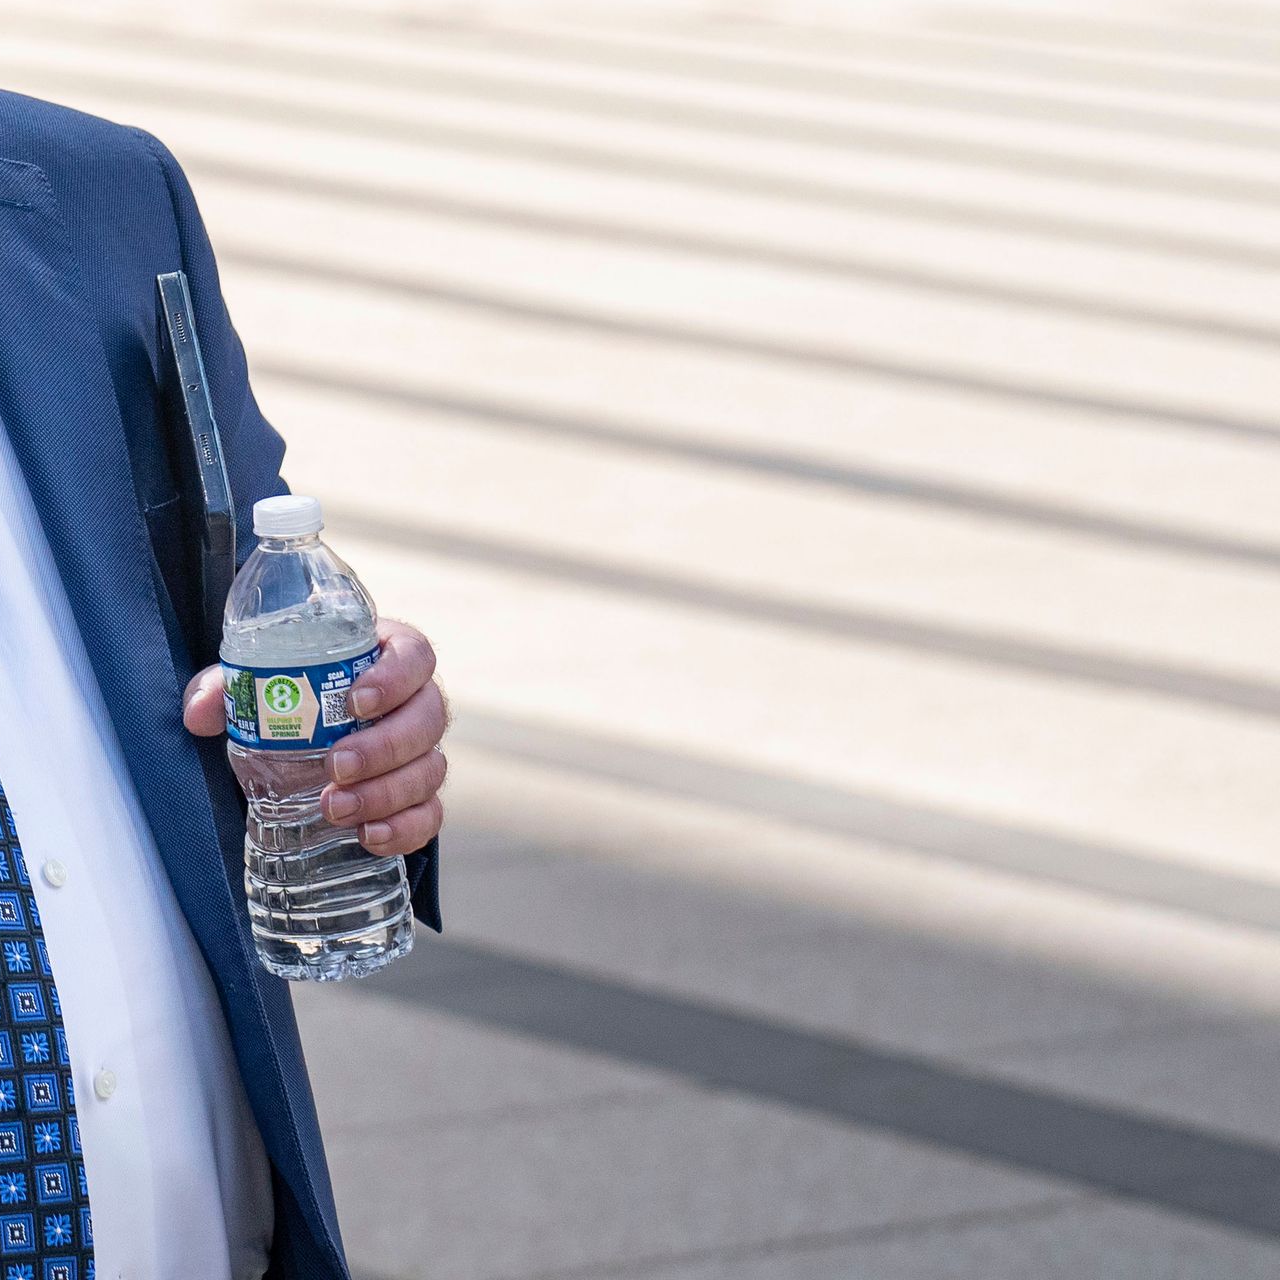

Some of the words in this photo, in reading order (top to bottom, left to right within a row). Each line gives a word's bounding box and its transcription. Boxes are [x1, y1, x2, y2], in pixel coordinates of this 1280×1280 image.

[328, 671, 344, 680] SCAN
[321, 681, 334, 690] FOR
[335, 678, 351, 688] MORE
